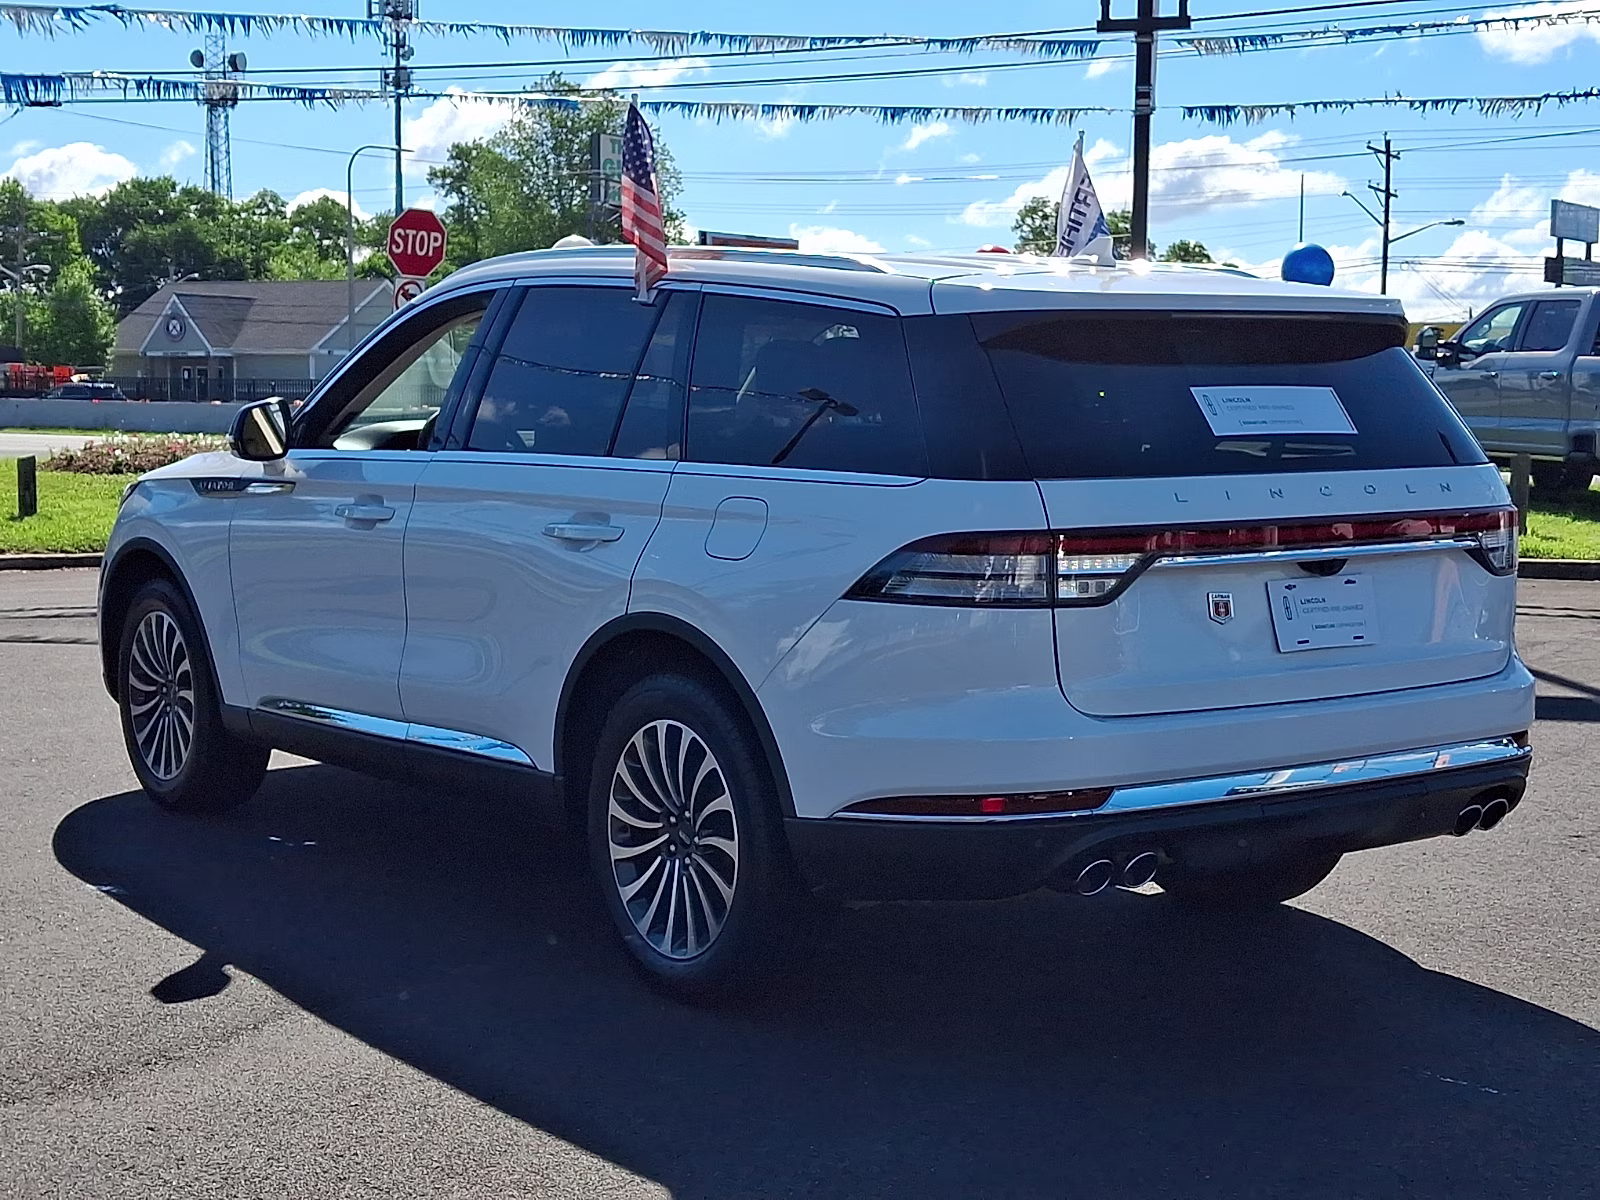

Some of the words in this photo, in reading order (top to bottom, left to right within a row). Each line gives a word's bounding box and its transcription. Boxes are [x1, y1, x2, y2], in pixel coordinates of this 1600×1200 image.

[392, 228, 442, 257] STOP
[1174, 482, 1452, 502] LINCOLN
[1300, 597, 1326, 605] LINCOLN
